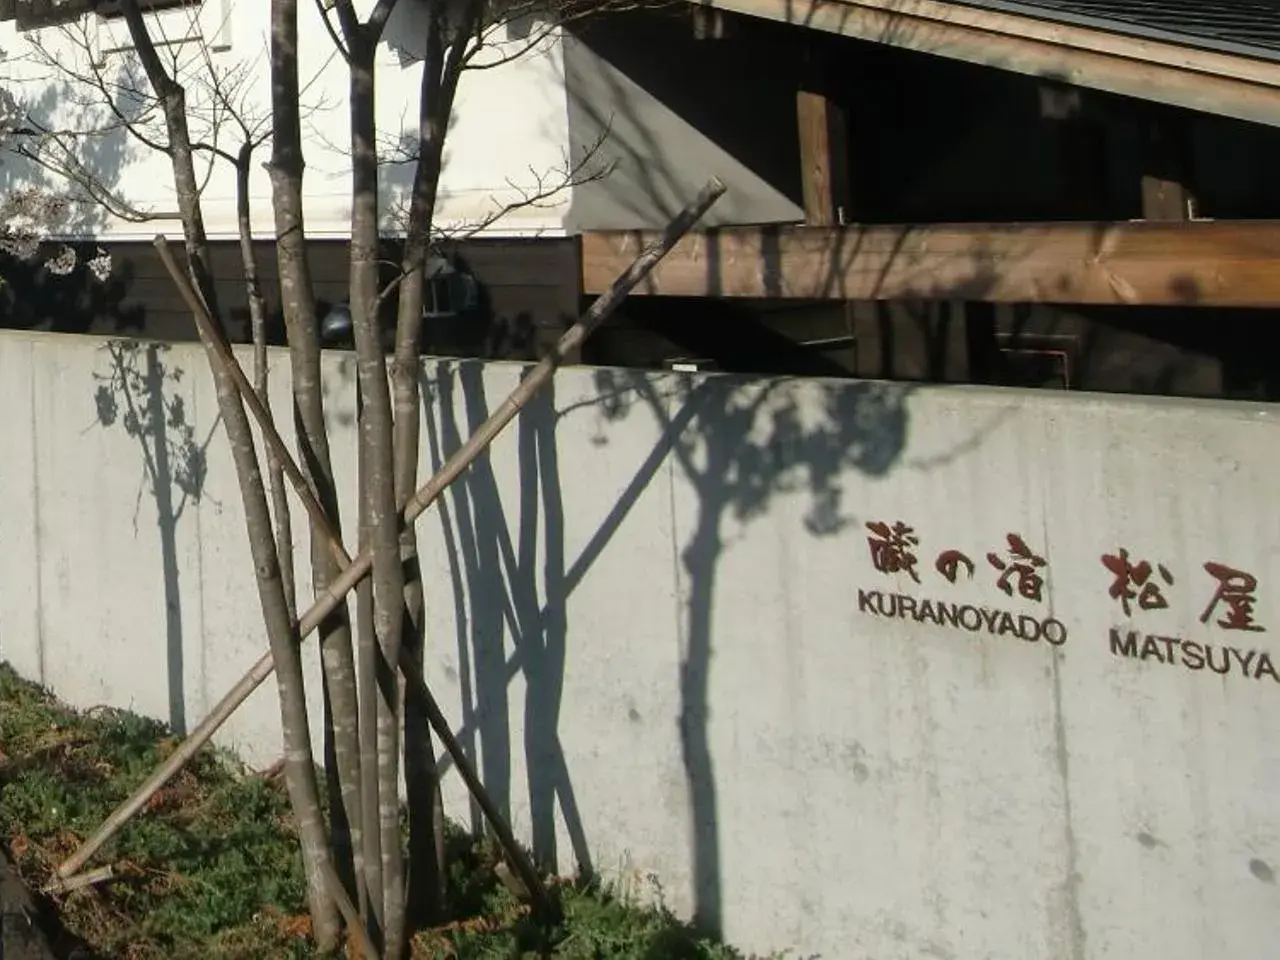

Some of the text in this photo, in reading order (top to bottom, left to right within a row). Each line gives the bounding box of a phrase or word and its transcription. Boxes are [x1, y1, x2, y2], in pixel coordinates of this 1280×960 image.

[1100, 548, 1266, 632] 松屋
[858, 588, 1280, 683] KURANOYADO MATSUYA
